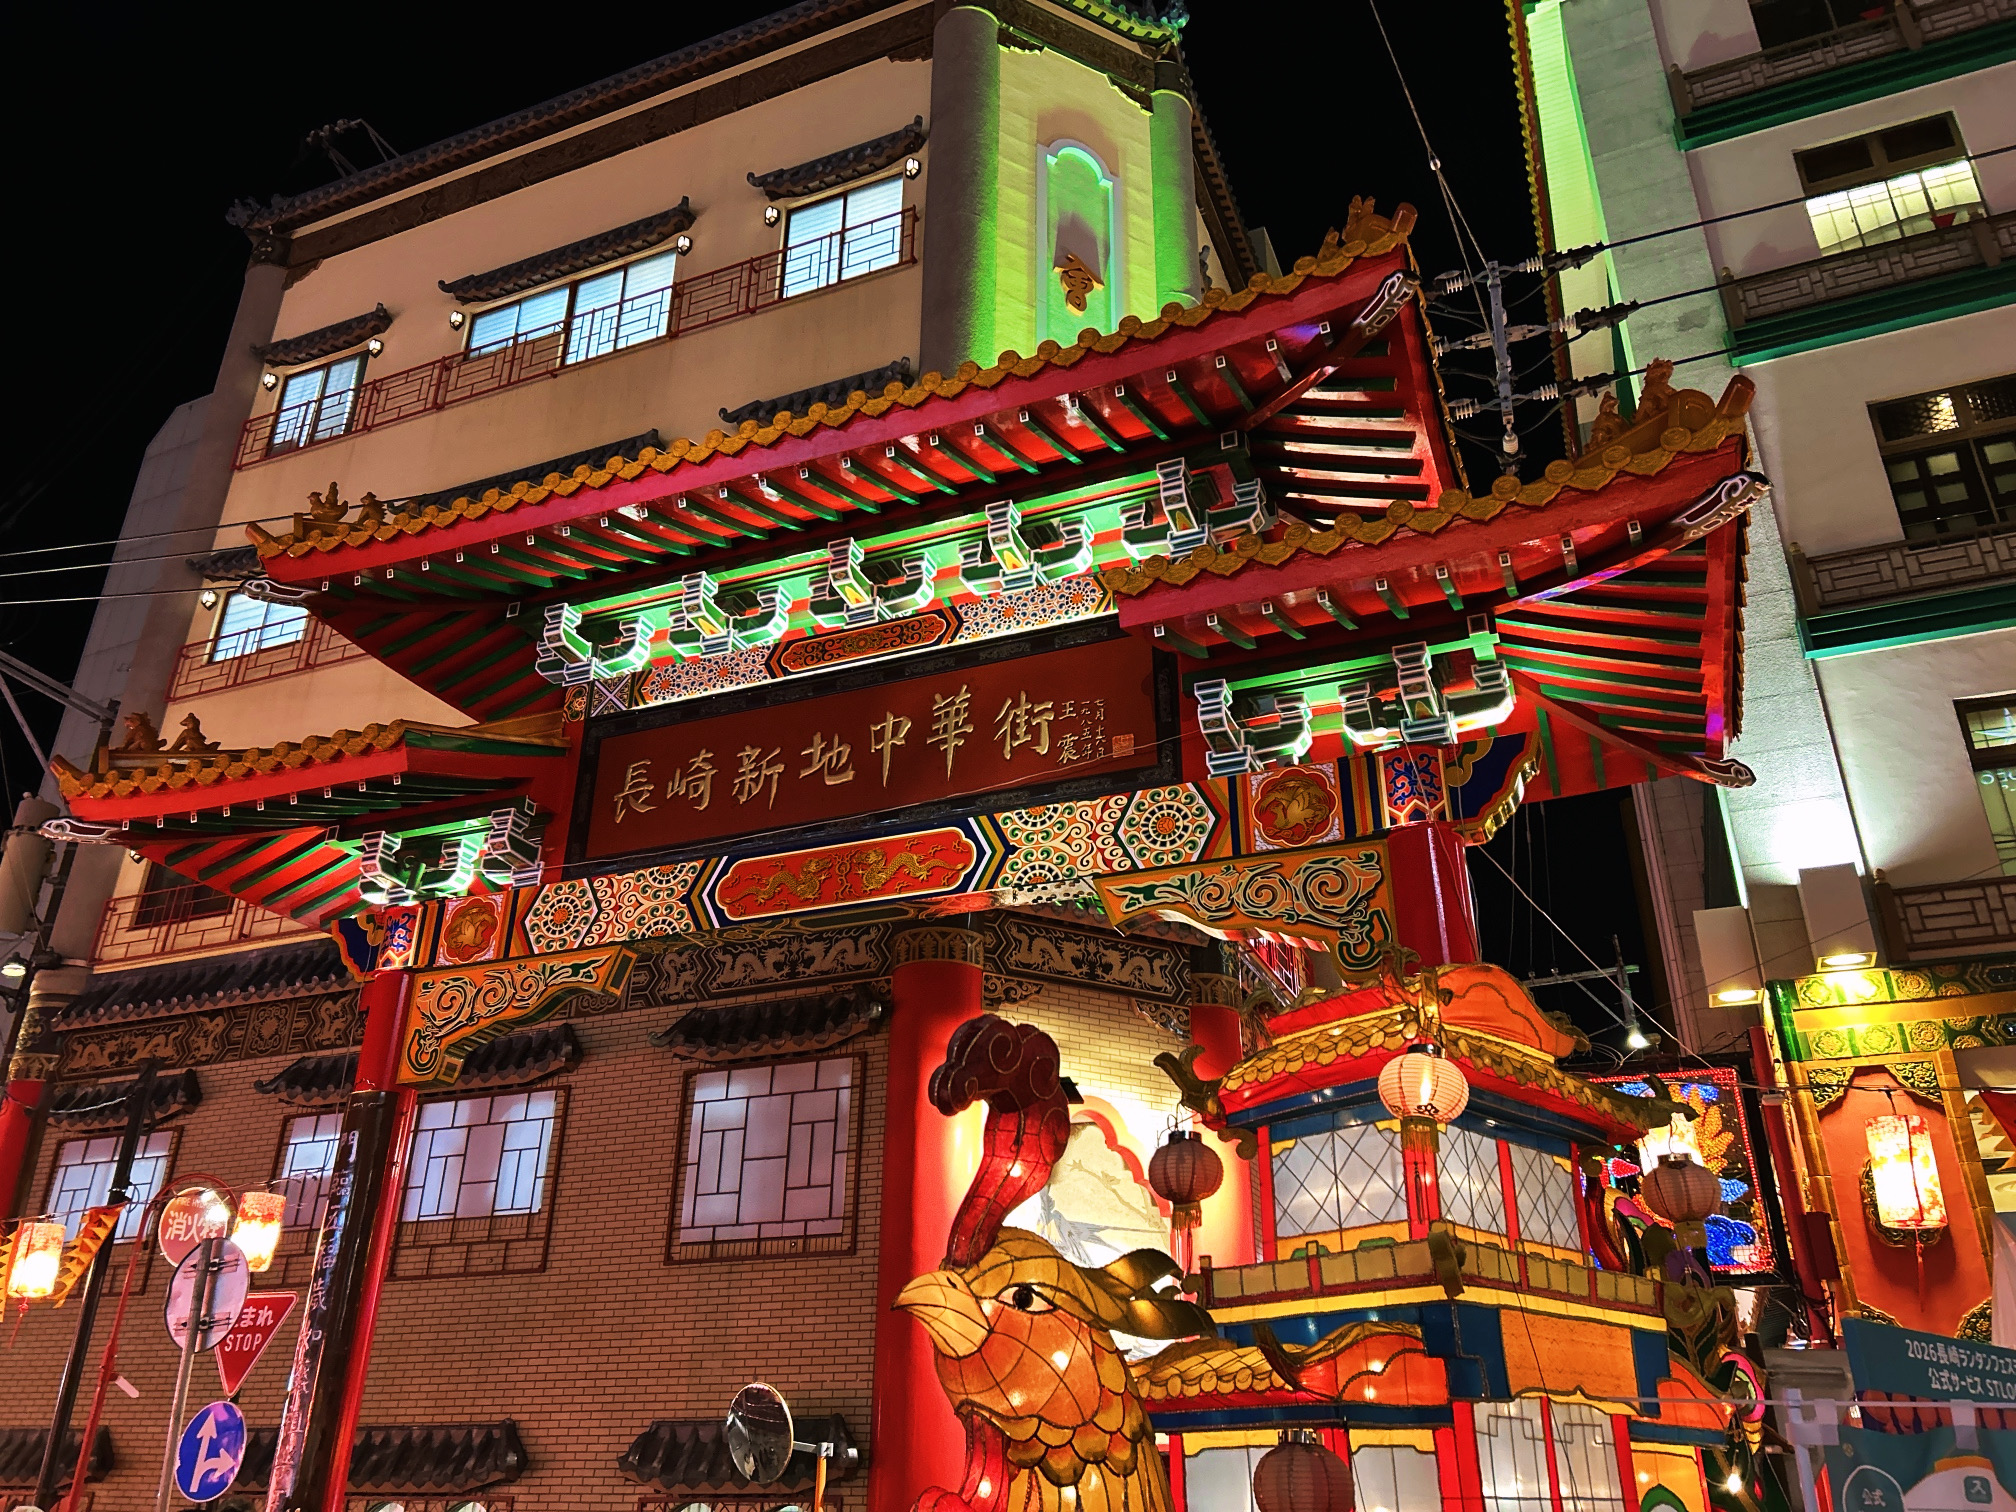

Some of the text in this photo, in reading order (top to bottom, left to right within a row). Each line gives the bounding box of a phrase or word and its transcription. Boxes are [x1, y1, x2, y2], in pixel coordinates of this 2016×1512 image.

[613, 684, 1055, 824] 長崎新地中華街
[234, 1305, 274, 1328] まれ
[224, 1333, 263, 1352] STOP
[1928, 1366, 2016, 1400] 公式サービス STLO
